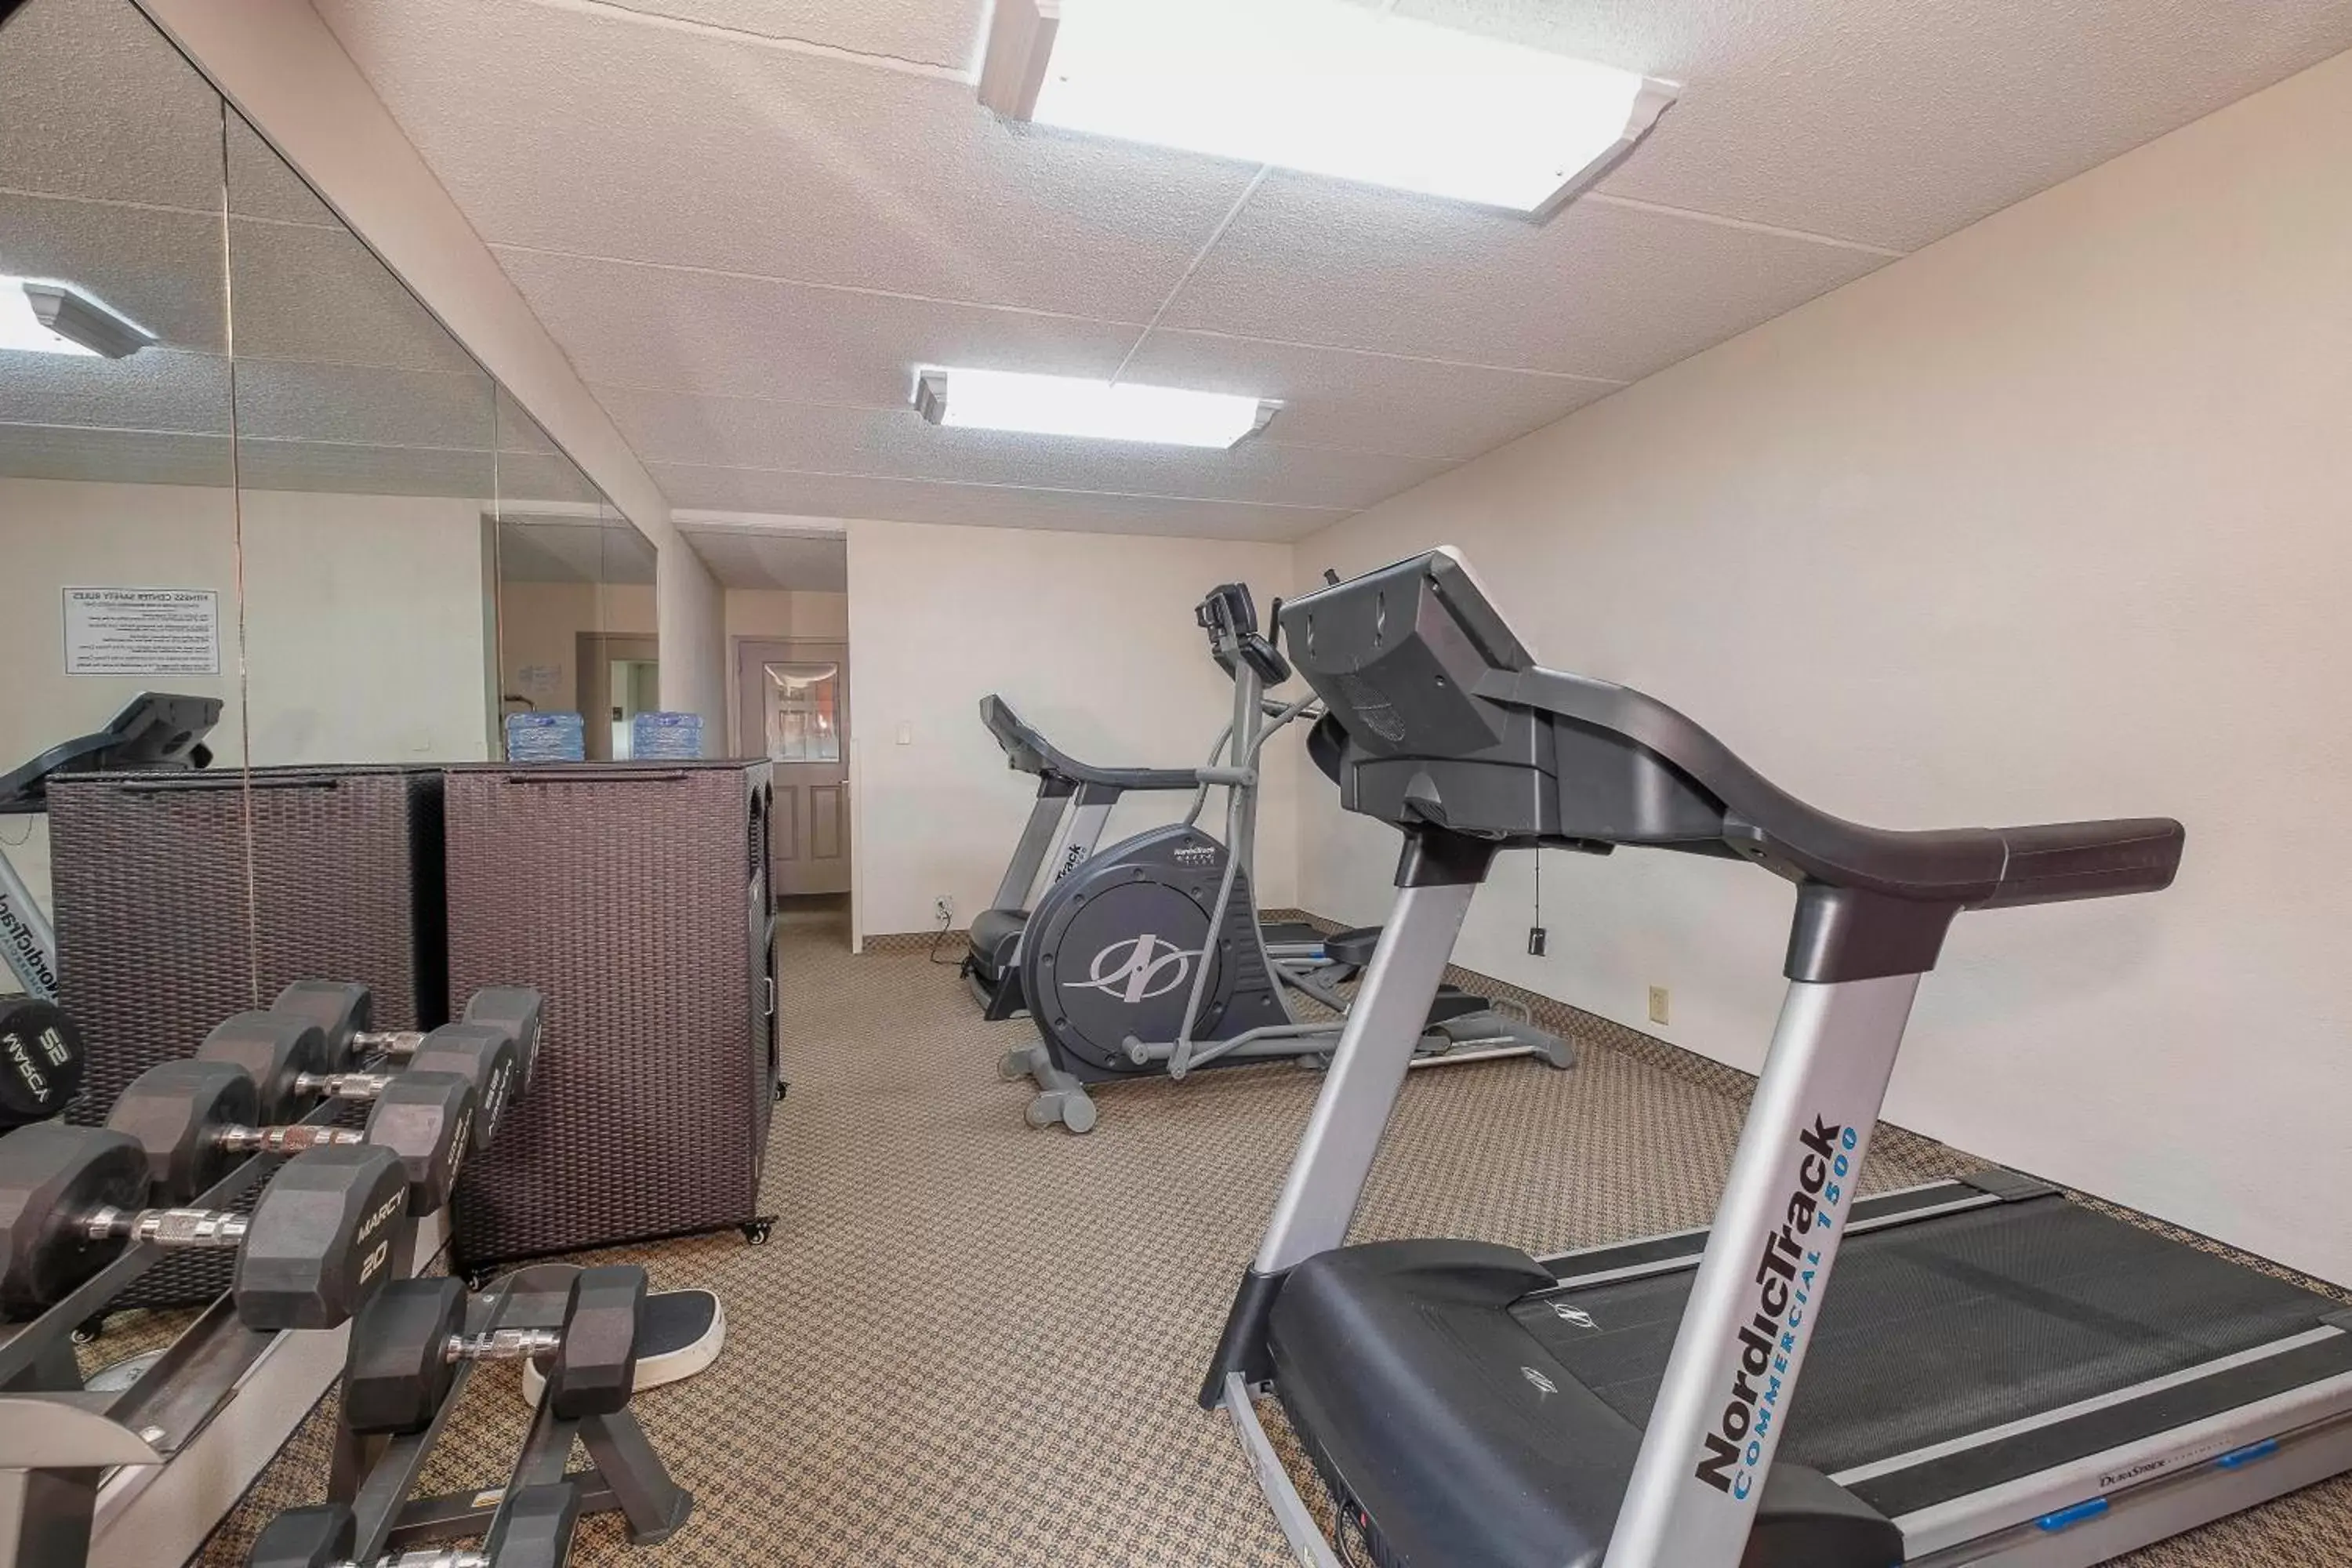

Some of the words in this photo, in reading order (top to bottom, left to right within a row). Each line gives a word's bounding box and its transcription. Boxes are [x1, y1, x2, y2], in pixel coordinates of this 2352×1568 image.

[357, 1185, 405, 1245] MARCY
[360, 1240, 388, 1286] 20
[1694, 1112, 1842, 1493] NordicTrack
[1733, 1250, 1822, 1501] COMMERCIAL
[1817, 1126, 1858, 1230] 1500
